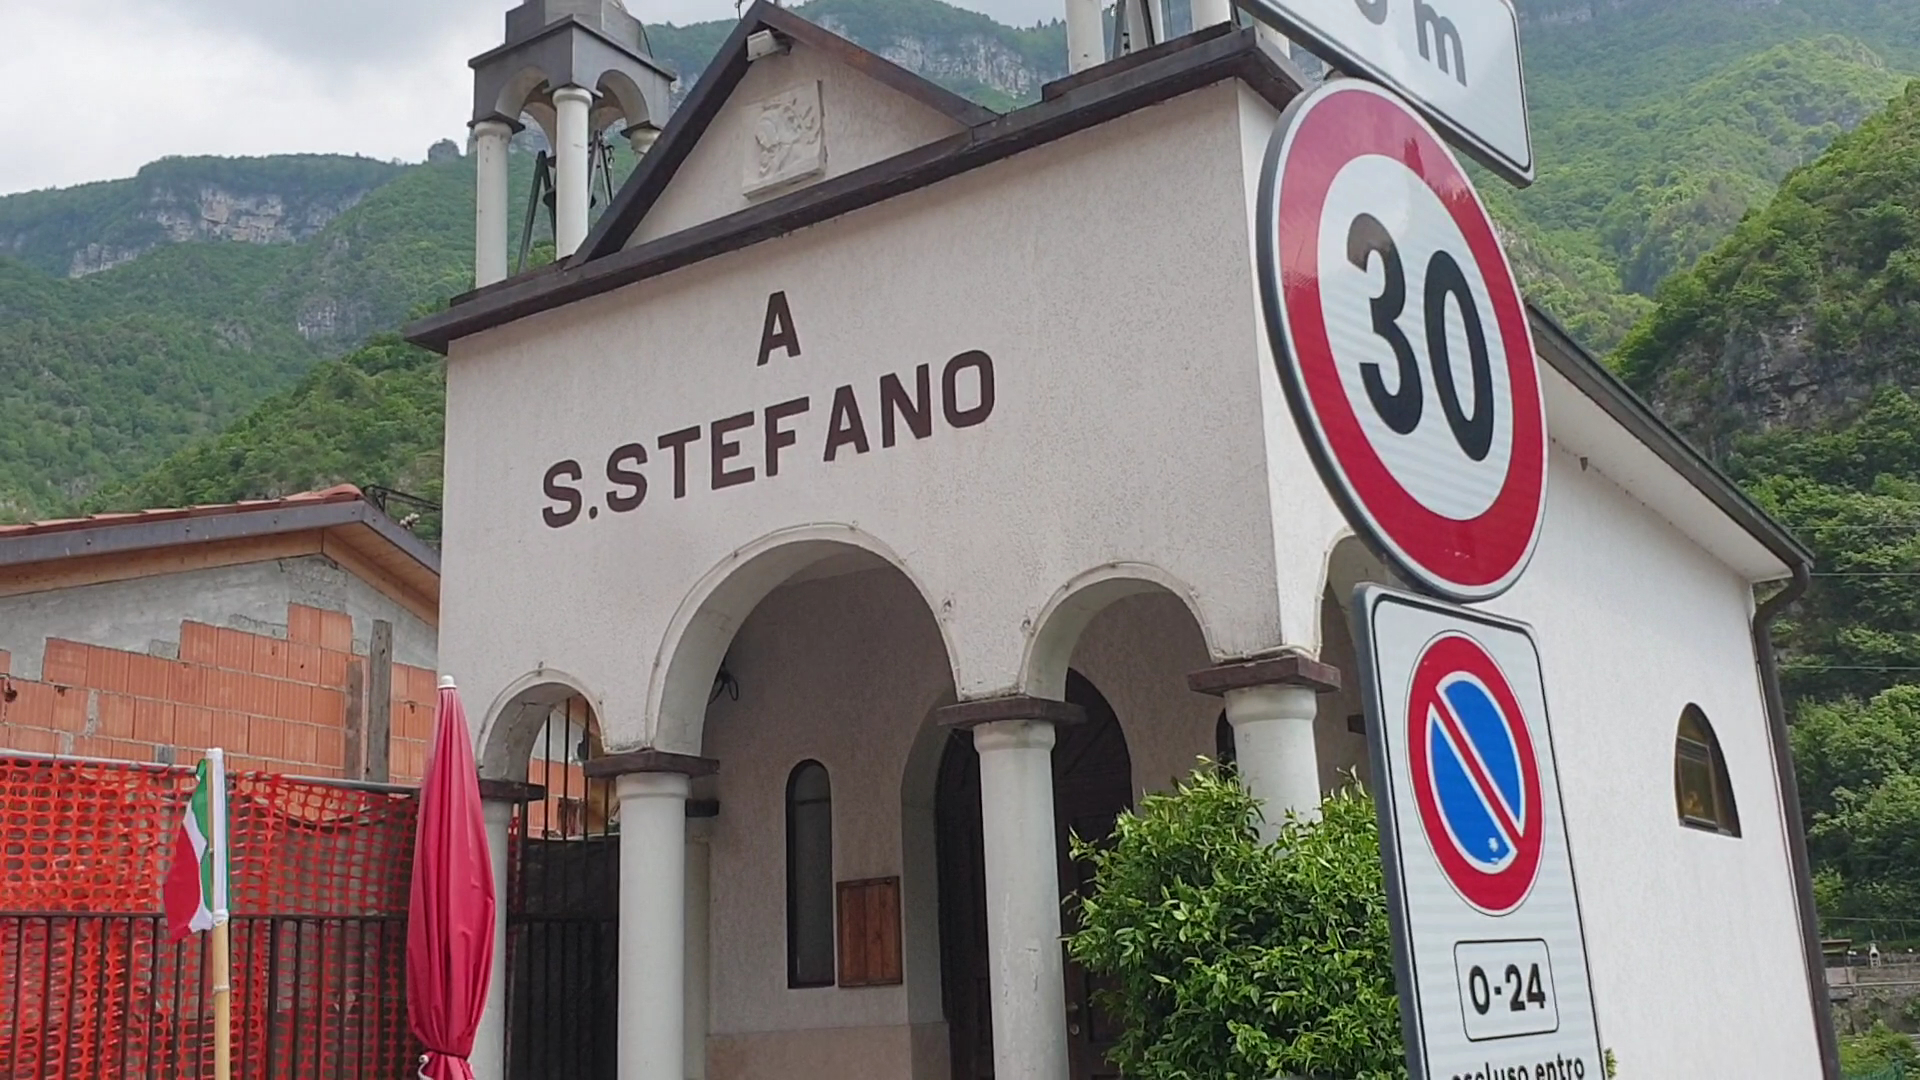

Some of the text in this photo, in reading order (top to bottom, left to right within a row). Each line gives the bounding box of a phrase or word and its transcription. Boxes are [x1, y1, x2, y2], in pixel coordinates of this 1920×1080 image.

[1414, 0, 1467, 87] m
[757, 290, 801, 366] A
[1347, 213, 1494, 461] 30
[542, 349, 995, 528] S.STEFANO
[1535, 1053, 1585, 1080] entro
